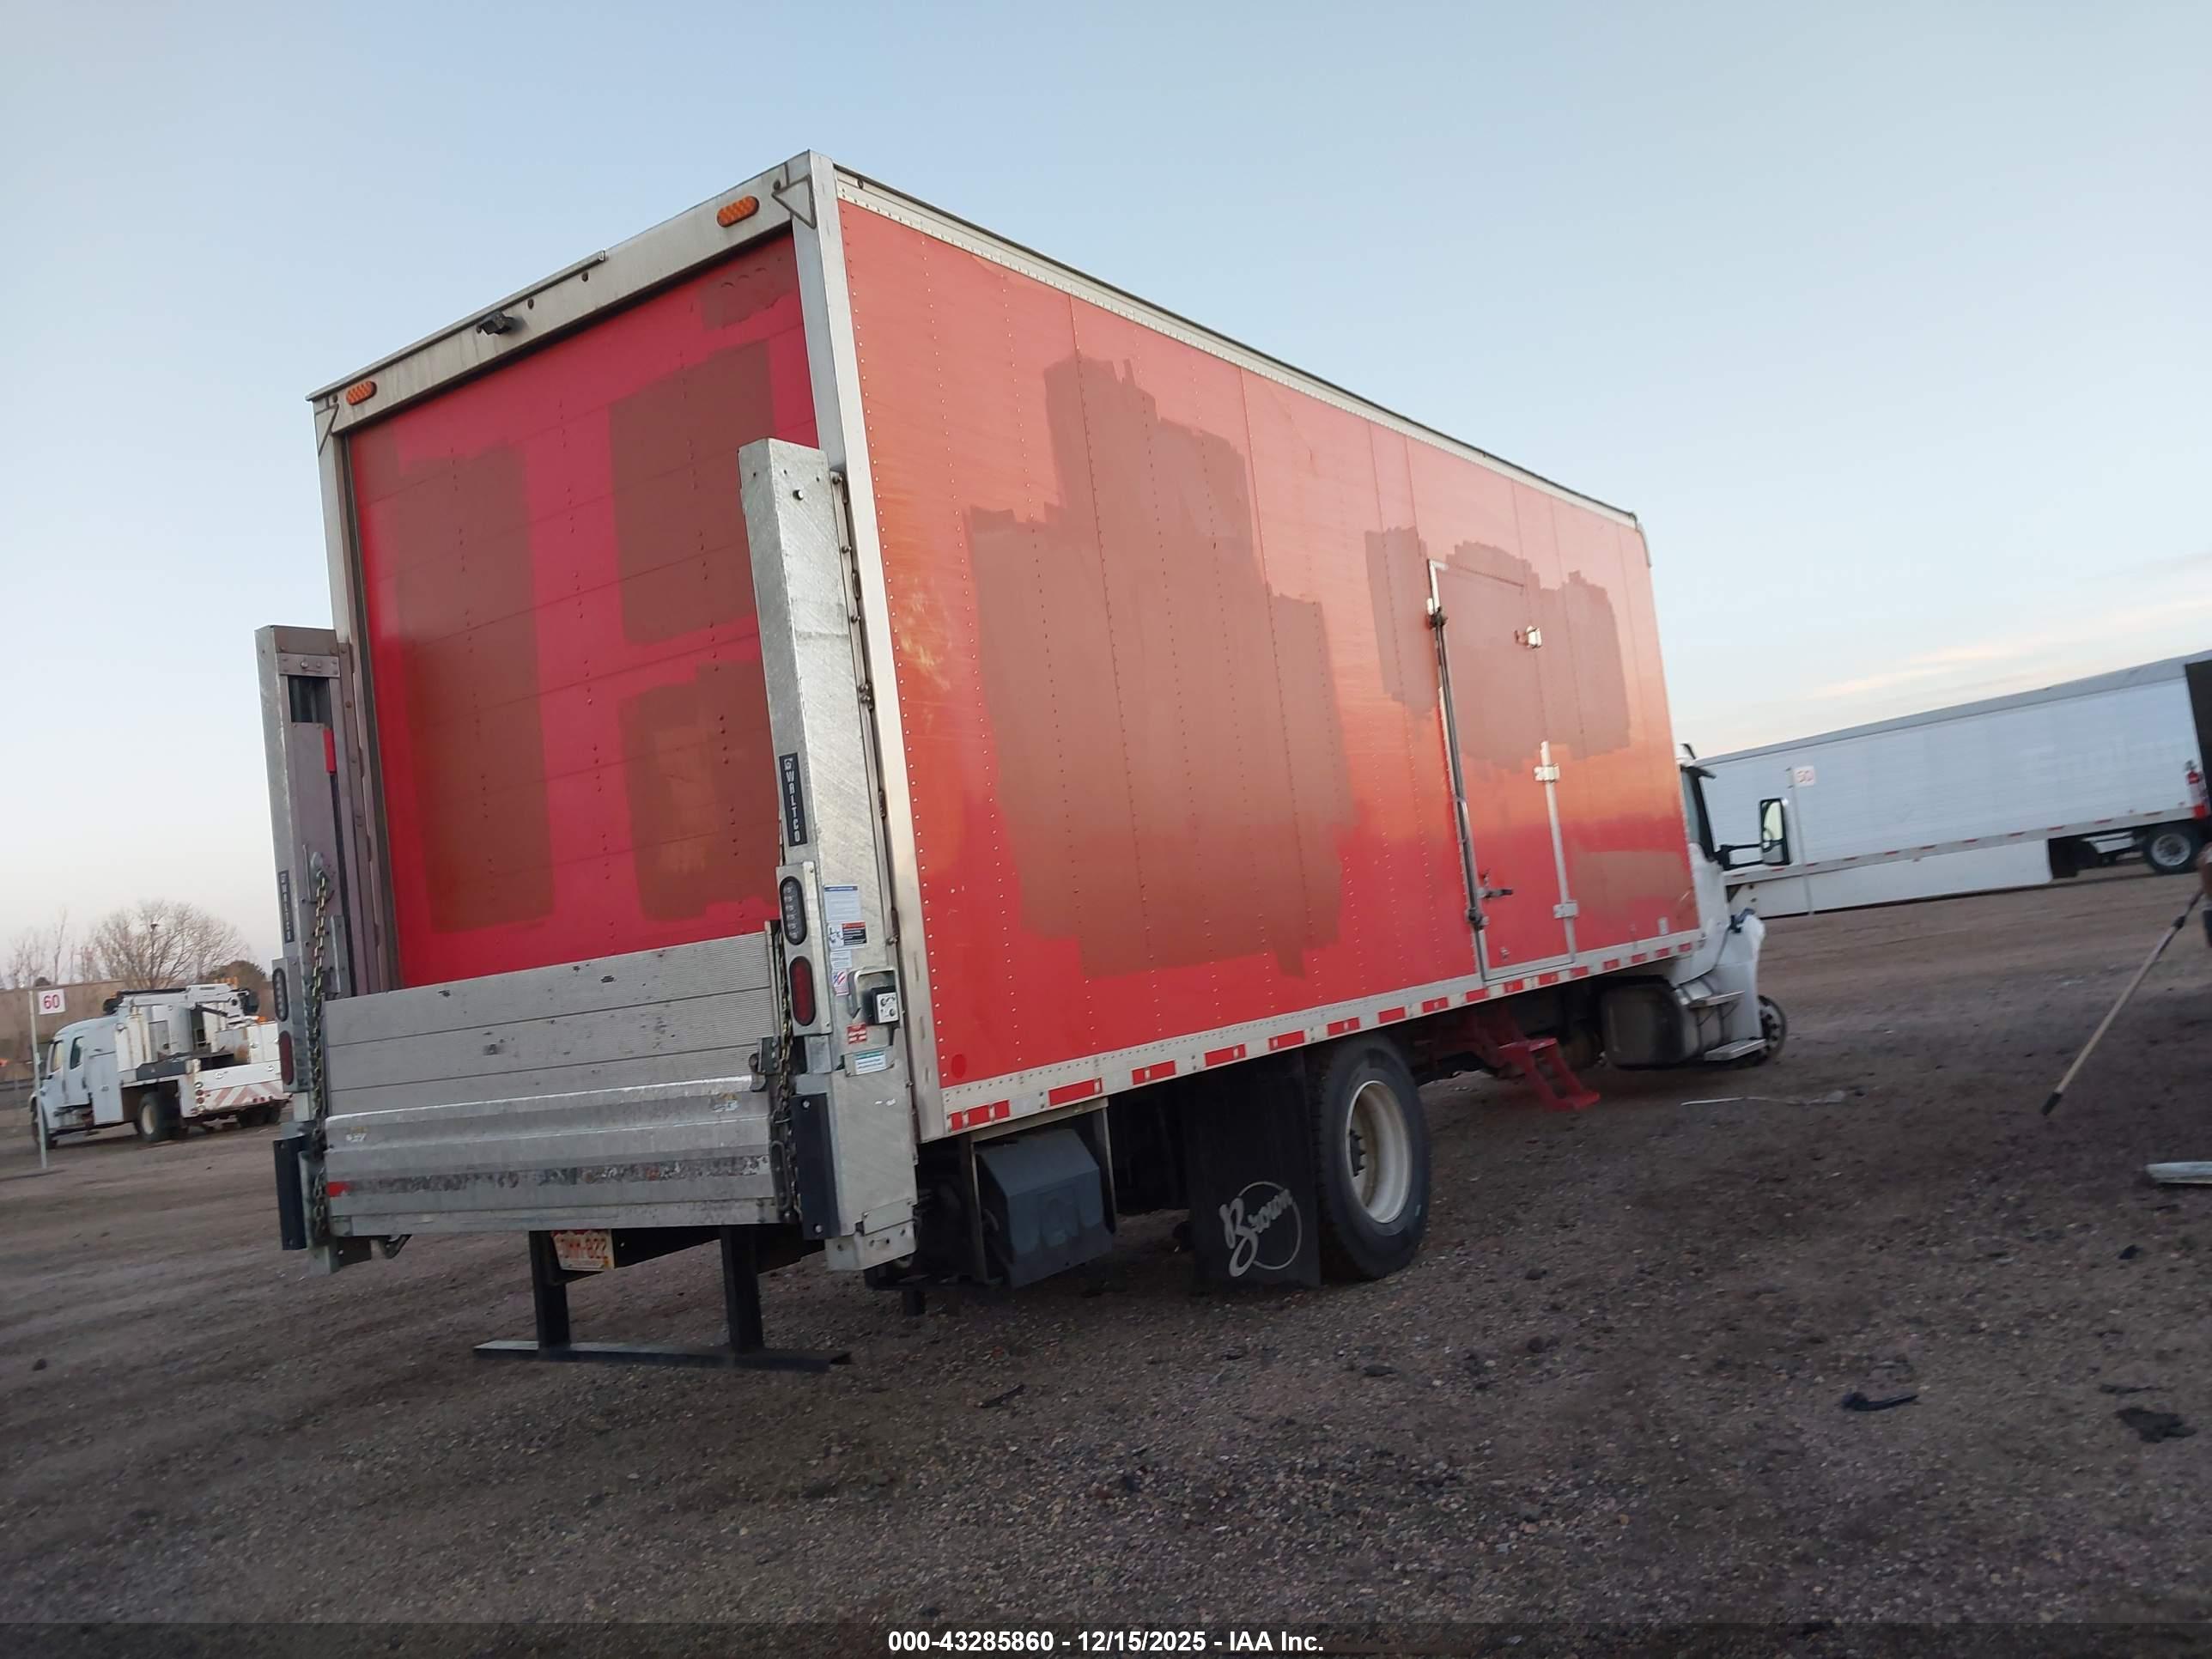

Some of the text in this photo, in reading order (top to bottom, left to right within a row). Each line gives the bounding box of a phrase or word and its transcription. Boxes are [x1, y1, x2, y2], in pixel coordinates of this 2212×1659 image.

[785, 770, 801, 842] WALTCO
[44, 994, 60, 1009] 60
[1219, 1189, 1293, 1277] Brown
